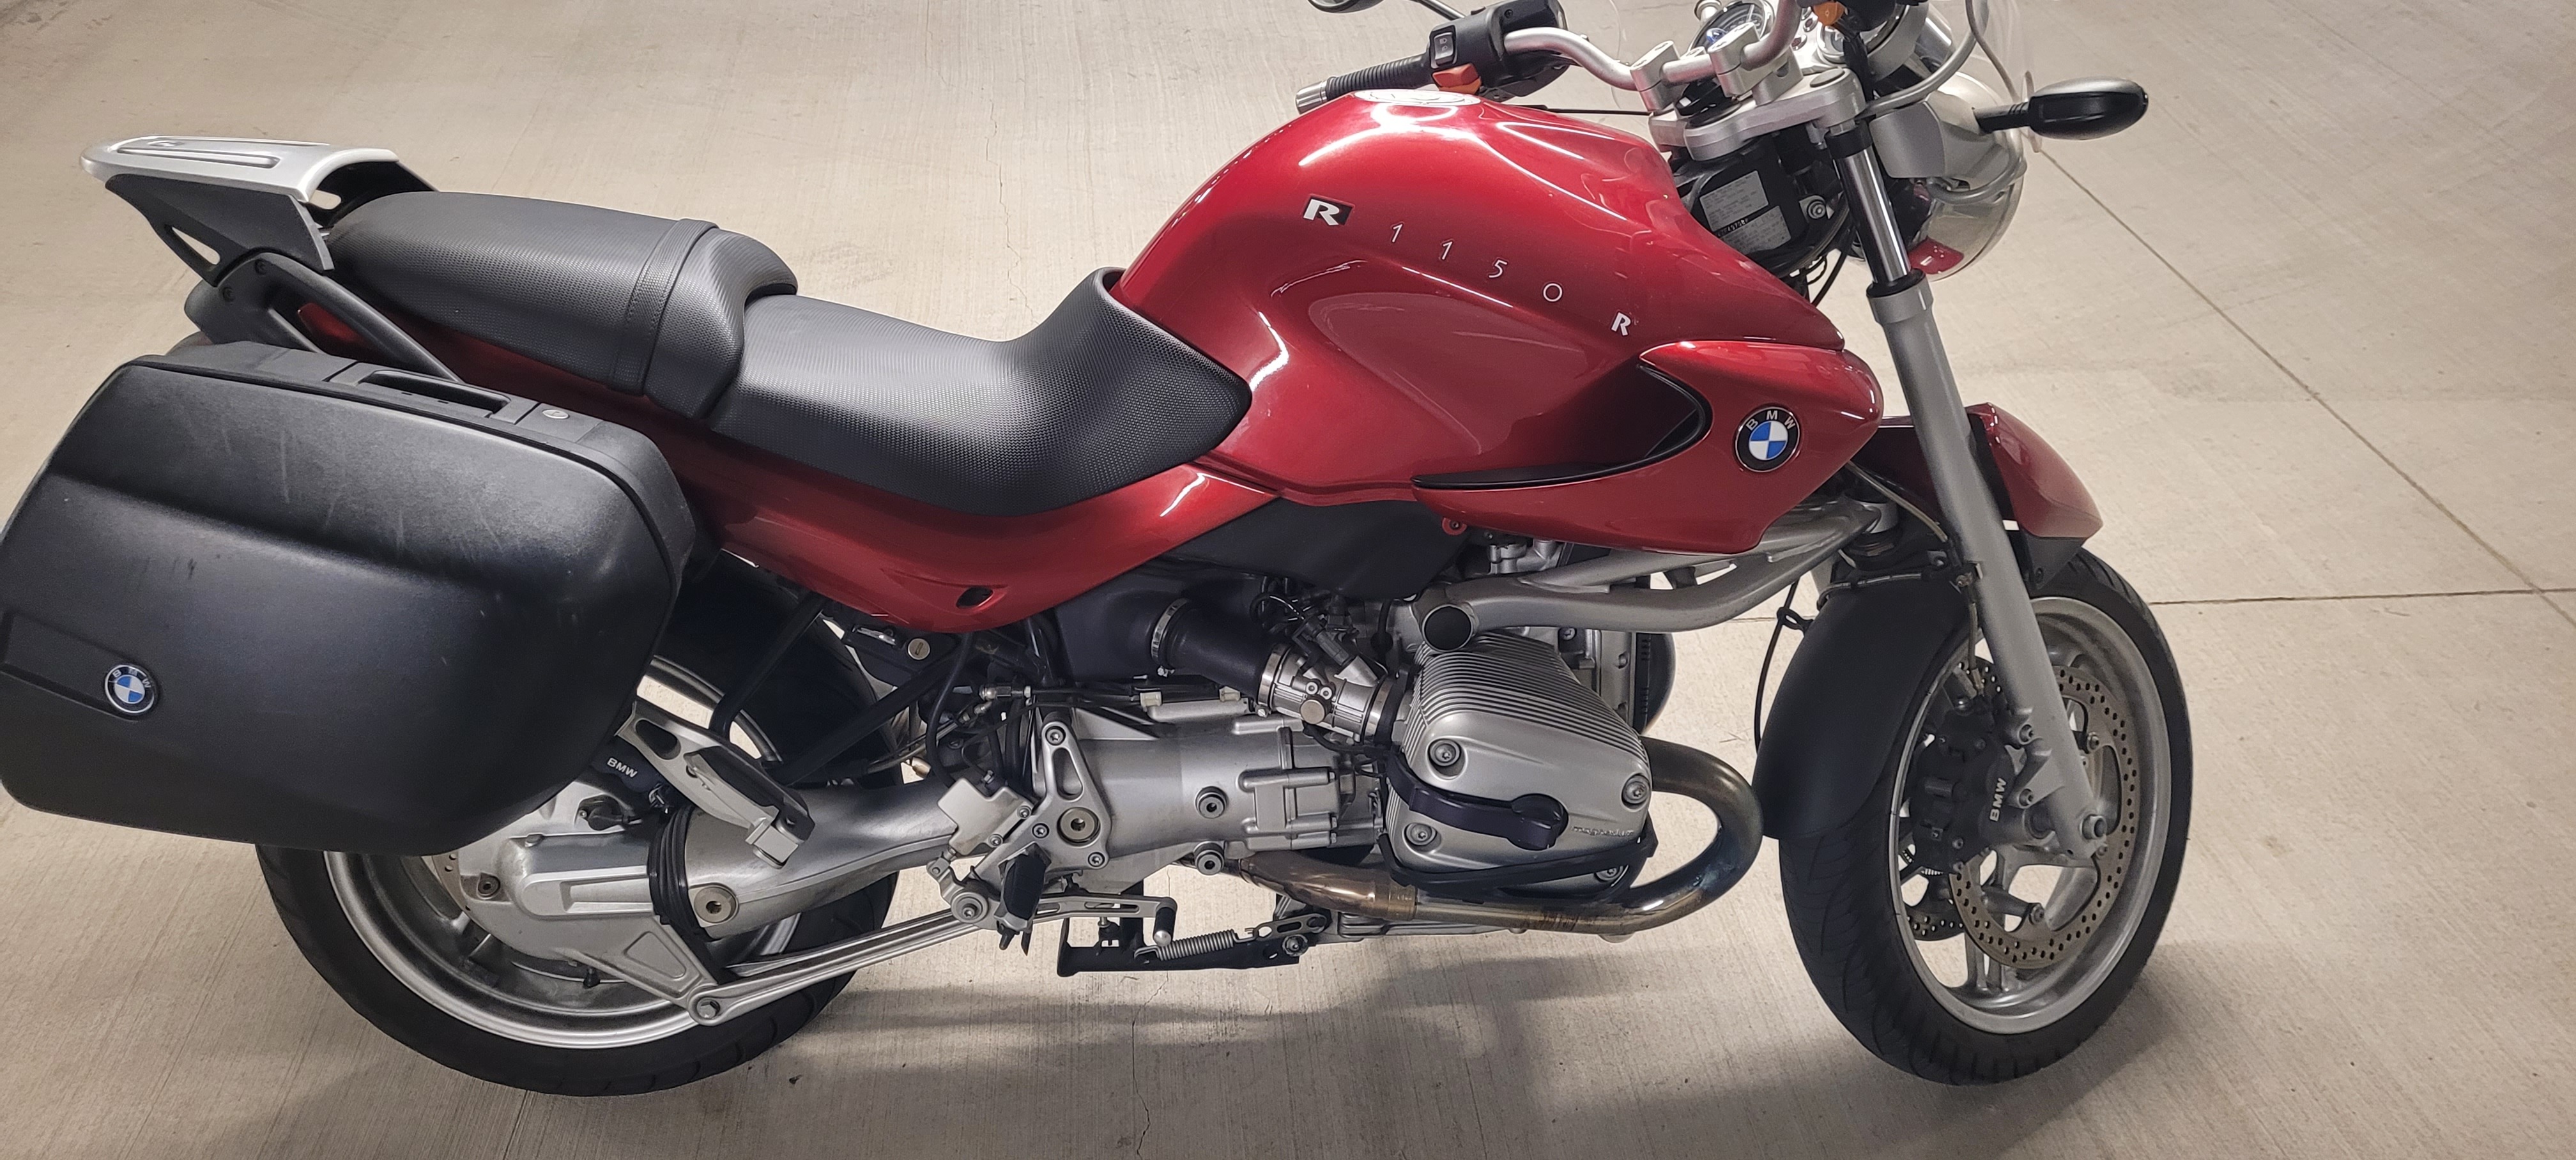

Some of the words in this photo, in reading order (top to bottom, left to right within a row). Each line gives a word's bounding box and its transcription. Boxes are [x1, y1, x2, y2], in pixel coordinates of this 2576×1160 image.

[1303, 198, 1340, 225] R
[1611, 312, 1630, 335] R
[1745, 410, 1796, 431] BMW
[112, 668, 151, 688] BMW
[607, 758, 638, 777] BMW
[1989, 777, 2007, 821] BMW
